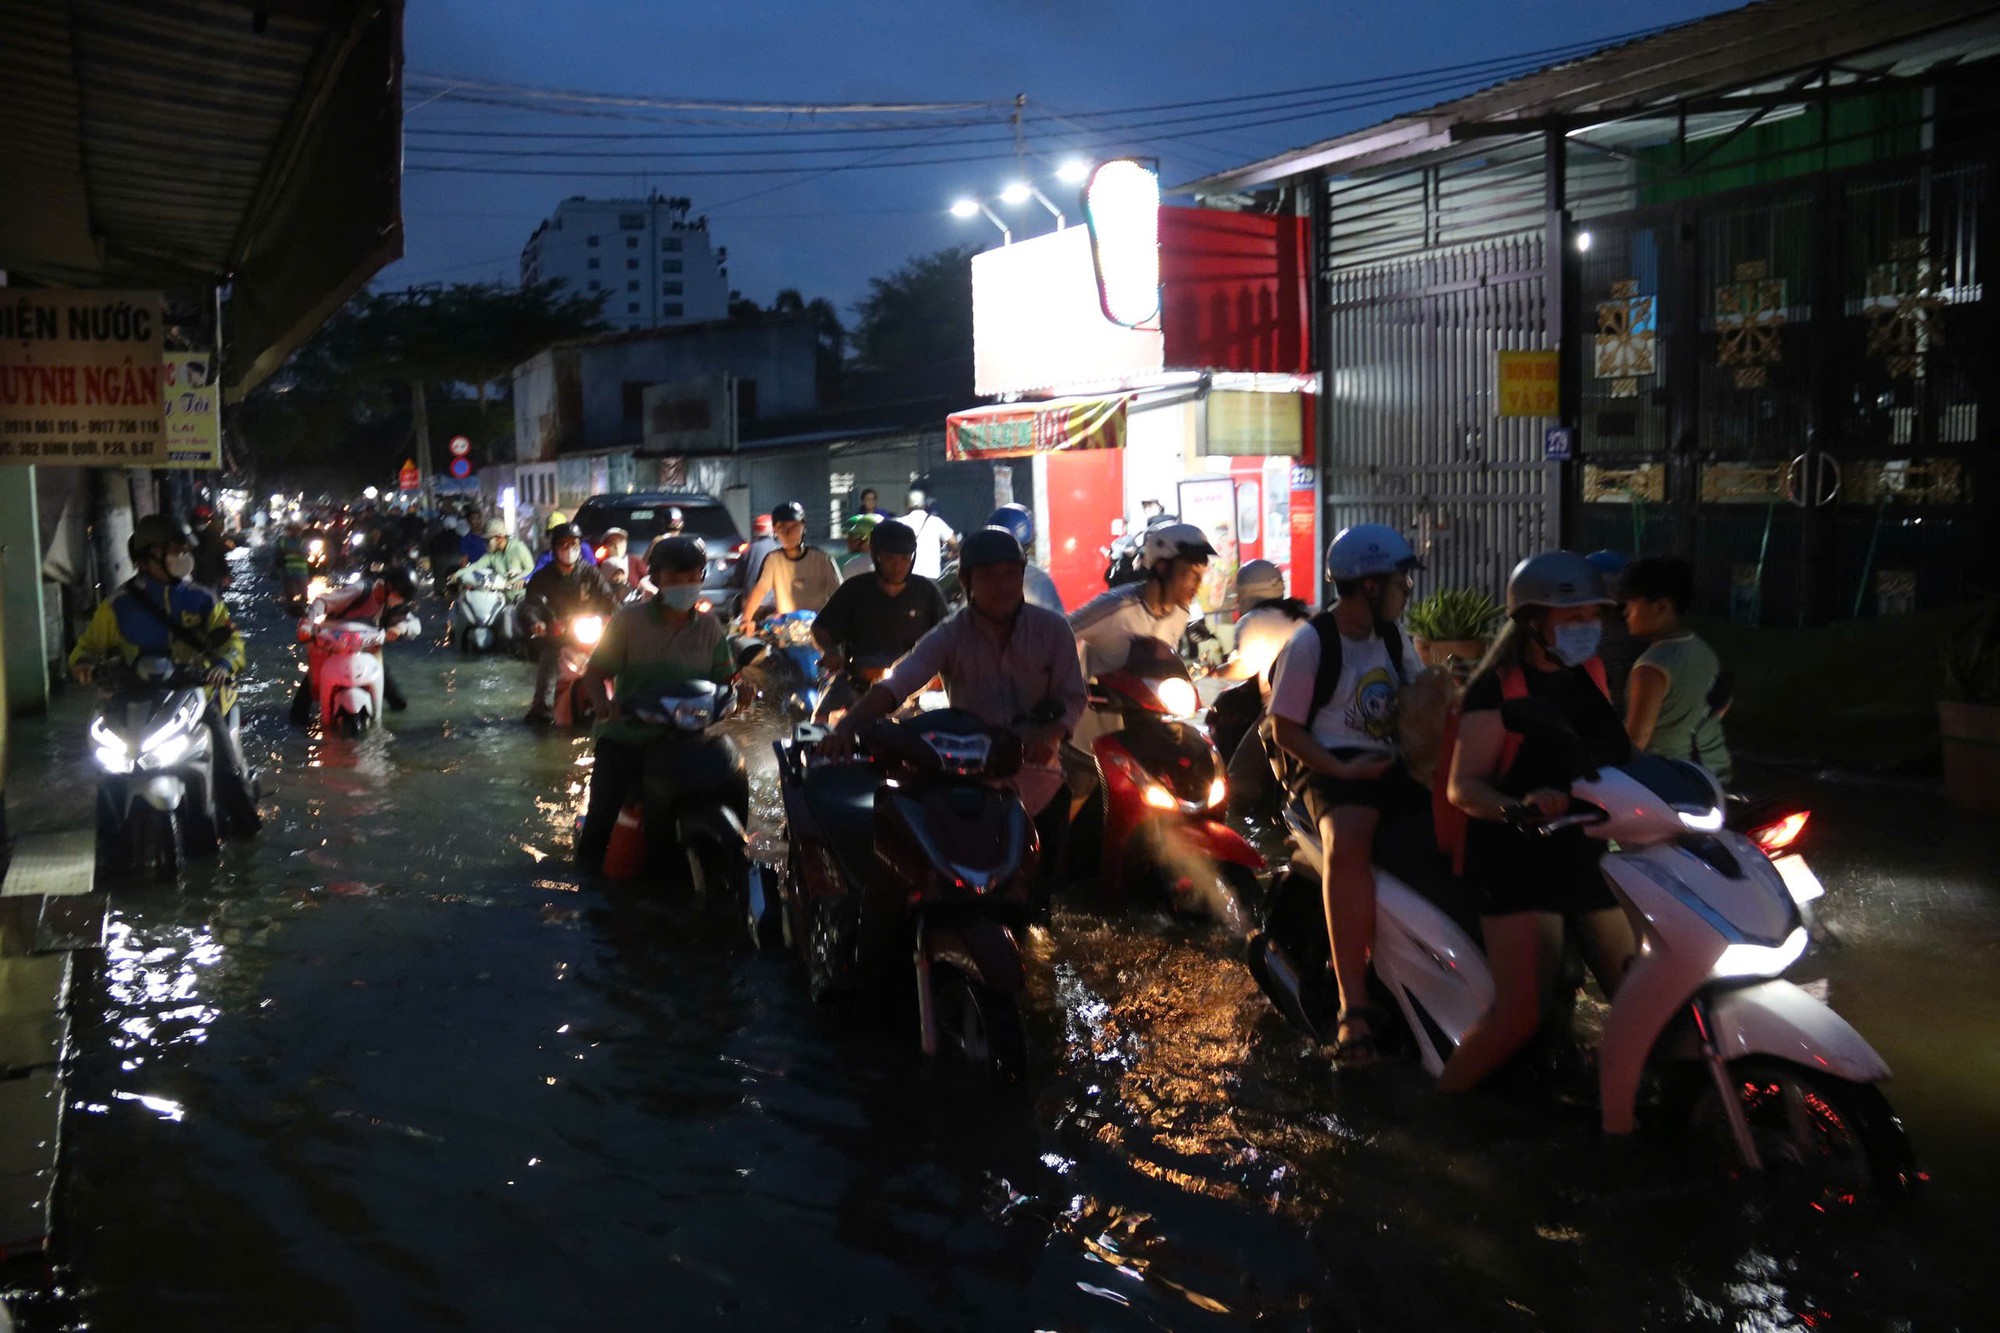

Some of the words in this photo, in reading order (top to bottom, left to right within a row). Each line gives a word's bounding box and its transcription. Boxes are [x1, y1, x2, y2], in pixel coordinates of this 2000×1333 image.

[0, 297, 57, 347] IỆN
[68, 302, 151, 341] NƯỚC
[83, 355, 158, 406] NGÂN
